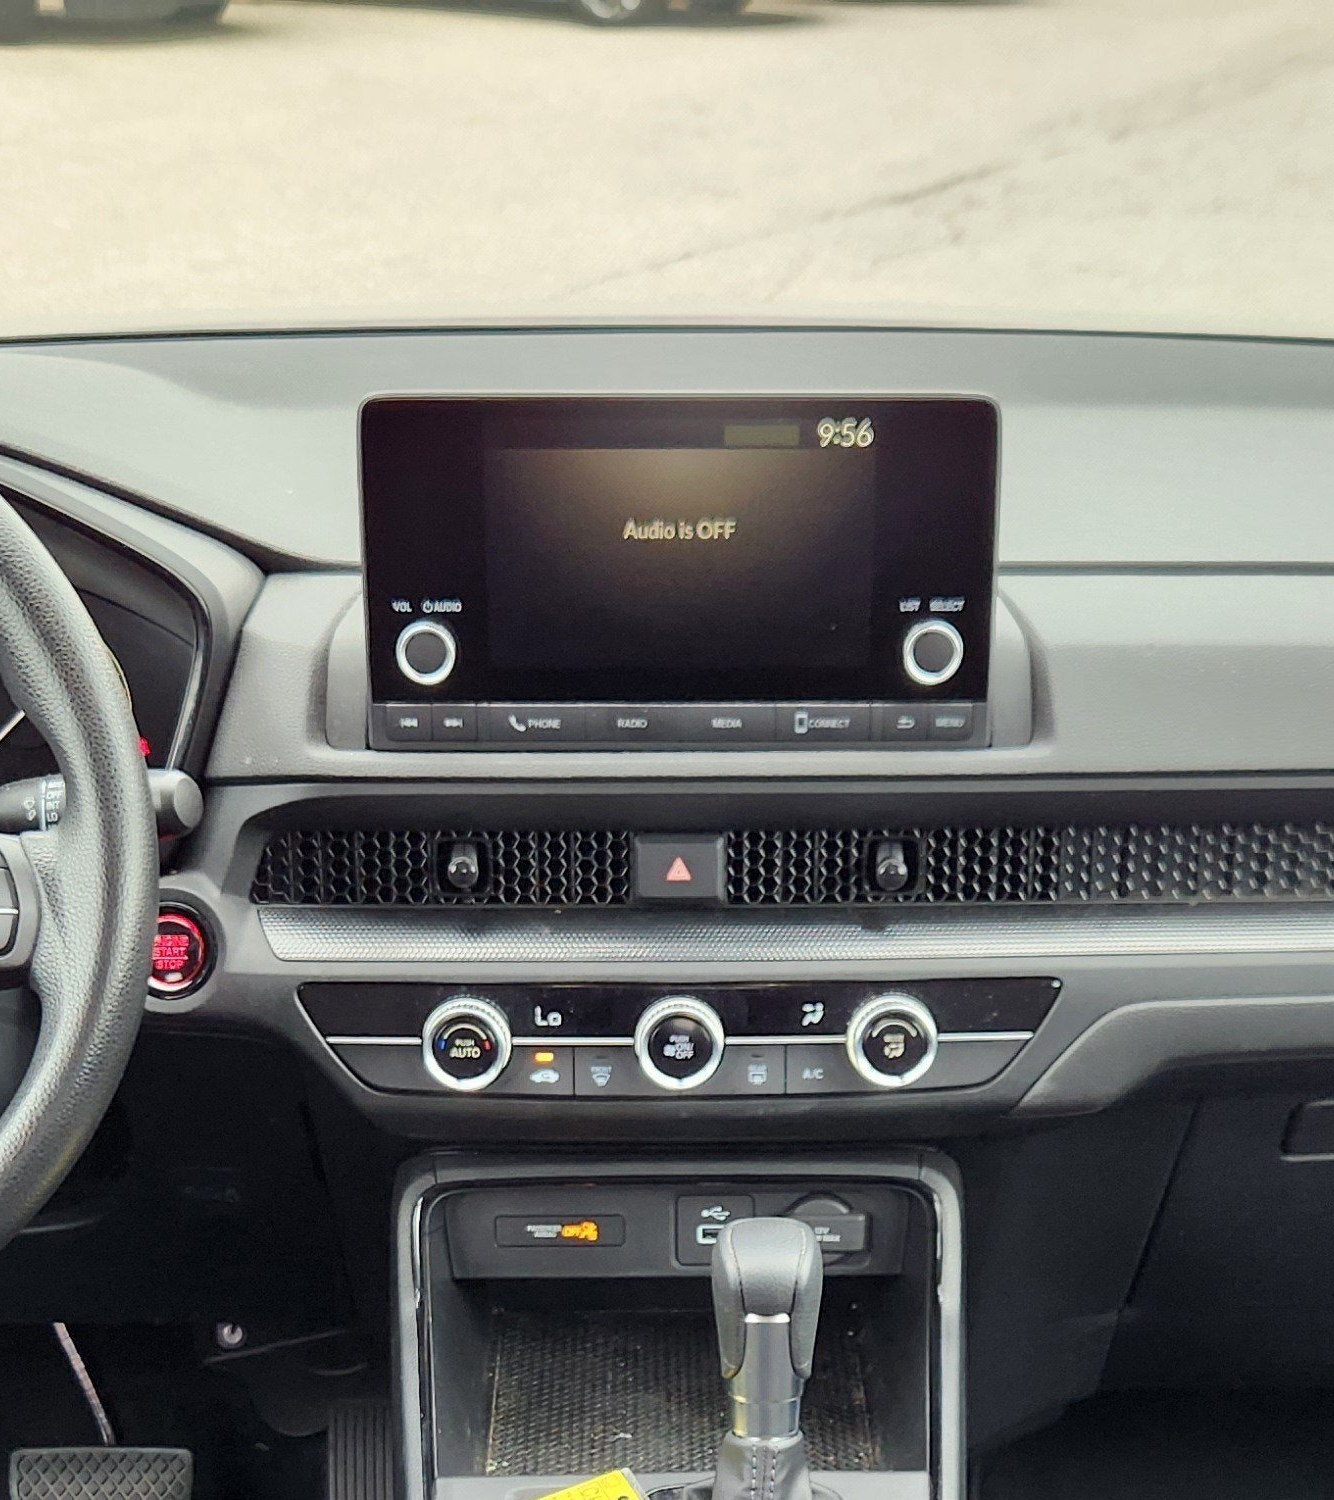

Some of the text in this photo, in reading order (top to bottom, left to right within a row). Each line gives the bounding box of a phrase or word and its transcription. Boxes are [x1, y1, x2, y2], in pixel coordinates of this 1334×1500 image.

[817, 417, 875, 448] 9:56
[623, 518, 738, 540] Audio is OFF
[392, 600, 412, 612] VOL
[434, 600, 462, 612] AUDIO
[528, 718, 562, 729] PHONE
[617, 718, 648, 729] RADIO
[712, 717, 743, 729] MEDIA
[808, 718, 851, 729] CONNECT
[152, 947, 187, 958] START
[154, 960, 185, 970] STOP
[449, 1047, 481, 1059] AUTO
[802, 1067, 824, 1080] A/C
